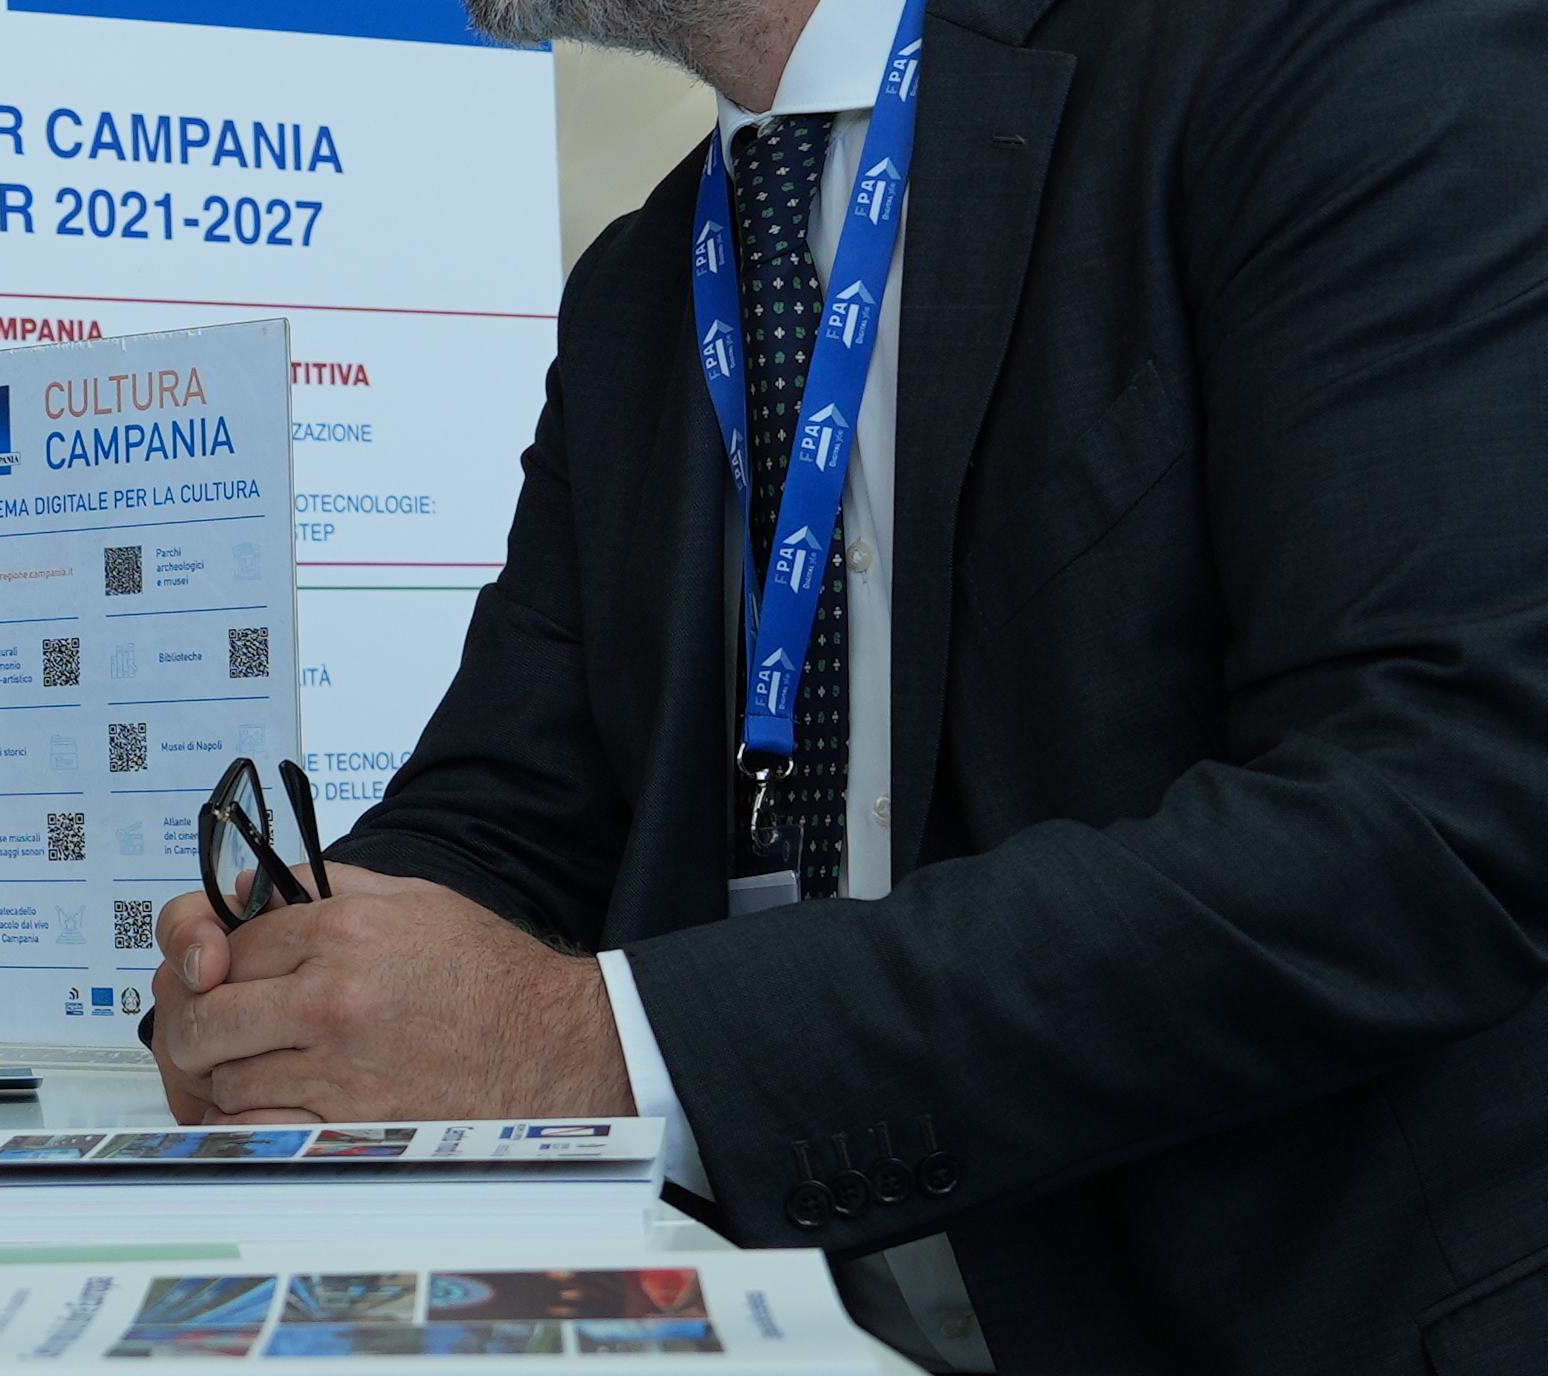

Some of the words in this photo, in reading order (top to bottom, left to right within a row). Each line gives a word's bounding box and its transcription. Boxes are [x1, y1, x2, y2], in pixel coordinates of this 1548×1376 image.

[886, 58, 908, 94] FPA
[46, 108, 344, 174] CAMPANIA
[855, 179, 875, 217] FPA
[55, 187, 323, 247] 2021-2027
[826, 302, 848, 340] FPA
[705, 343, 720, 381] FPA
[44, 367, 207, 420] CULTURA
[46, 416, 236, 471] CAMPANIA
[799, 425, 821, 463] FPA
[34, 491, 109, 516] DIGITALE
[113, 488, 147, 510] PER
[153, 486, 175, 506] LA
[180, 479, 261, 504] CULTURA
[155, 547, 182, 558] Parchi
[156, 560, 205, 573] archeologici
[774, 547, 795, 585] FPA
[163, 576, 189, 586] musei
[158, 652, 203, 663] Biblioteche
[755, 670, 772, 706] FPA
[3, 746, 28, 757] storici
[161, 741, 186, 752] Musei
[187, 741, 195, 751] di
[196, 740, 223, 752] Napoli
[325, 781, 384, 801] DELLE
[163, 816, 192, 827] Atlante
[8, 832, 41, 843] musicali
[164, 830, 177, 841] del
[20, 848, 45, 857] sonori
[173, 845, 200, 857] Camp
[21, 919, 33, 929] dal
[34, 921, 50, 929] vivo
[1, 933, 39, 945] Campania
